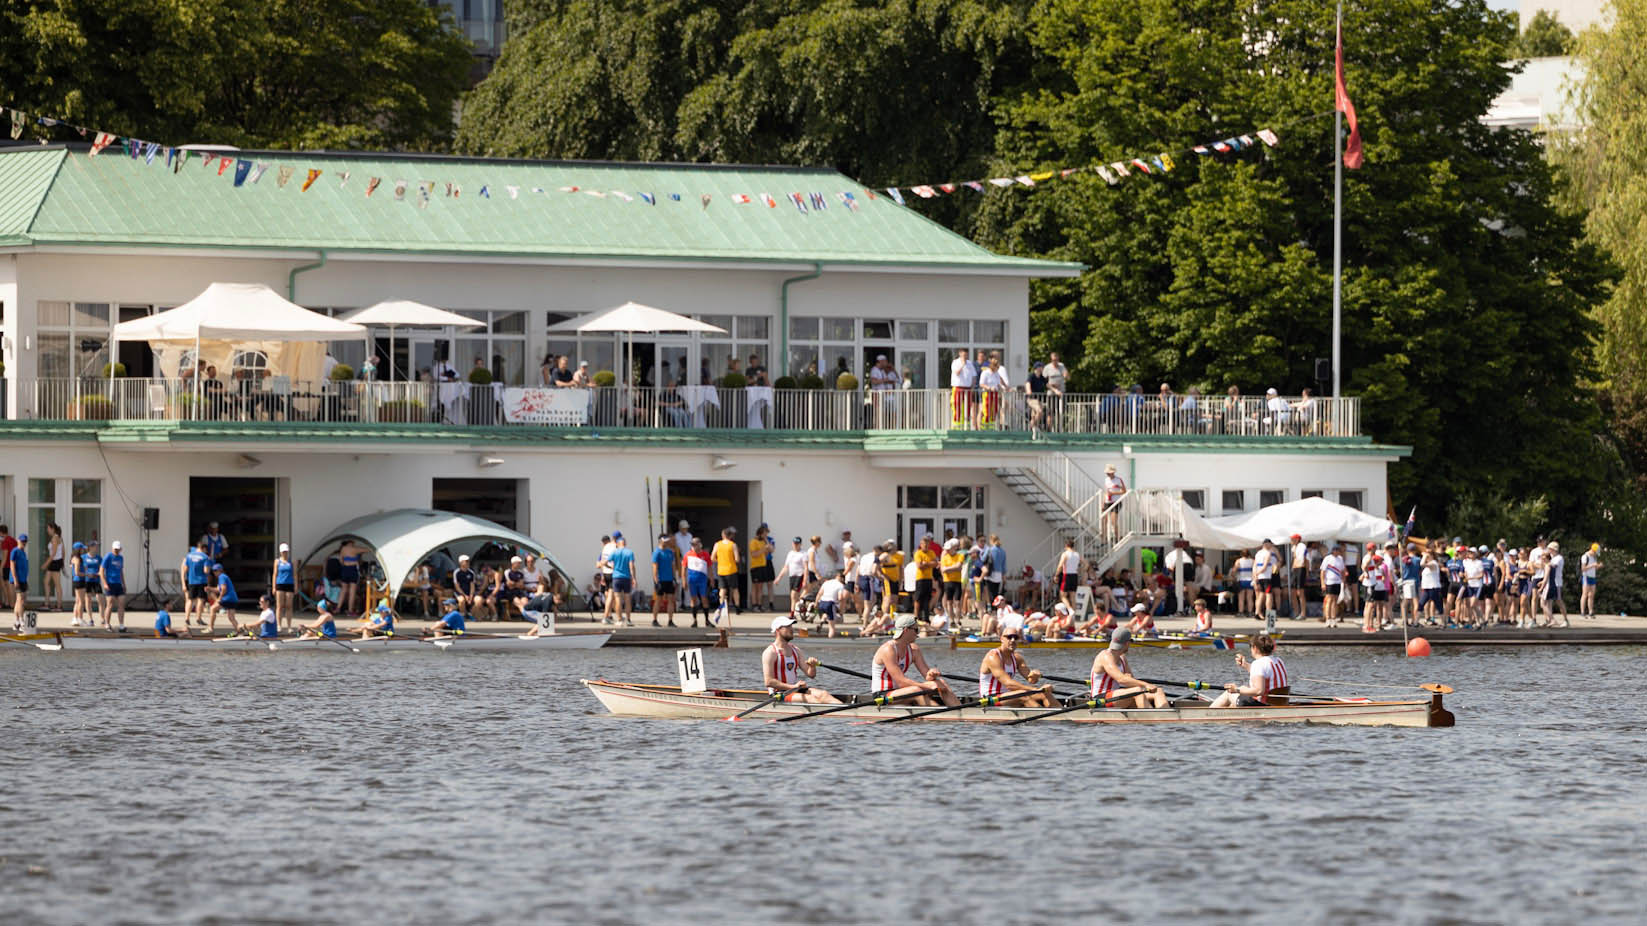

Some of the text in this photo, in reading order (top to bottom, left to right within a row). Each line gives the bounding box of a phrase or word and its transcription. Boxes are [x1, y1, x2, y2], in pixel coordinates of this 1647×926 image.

[26, 612, 37, 628] 18
[542, 613, 550, 629] 3
[679, 651, 700, 680] 14
